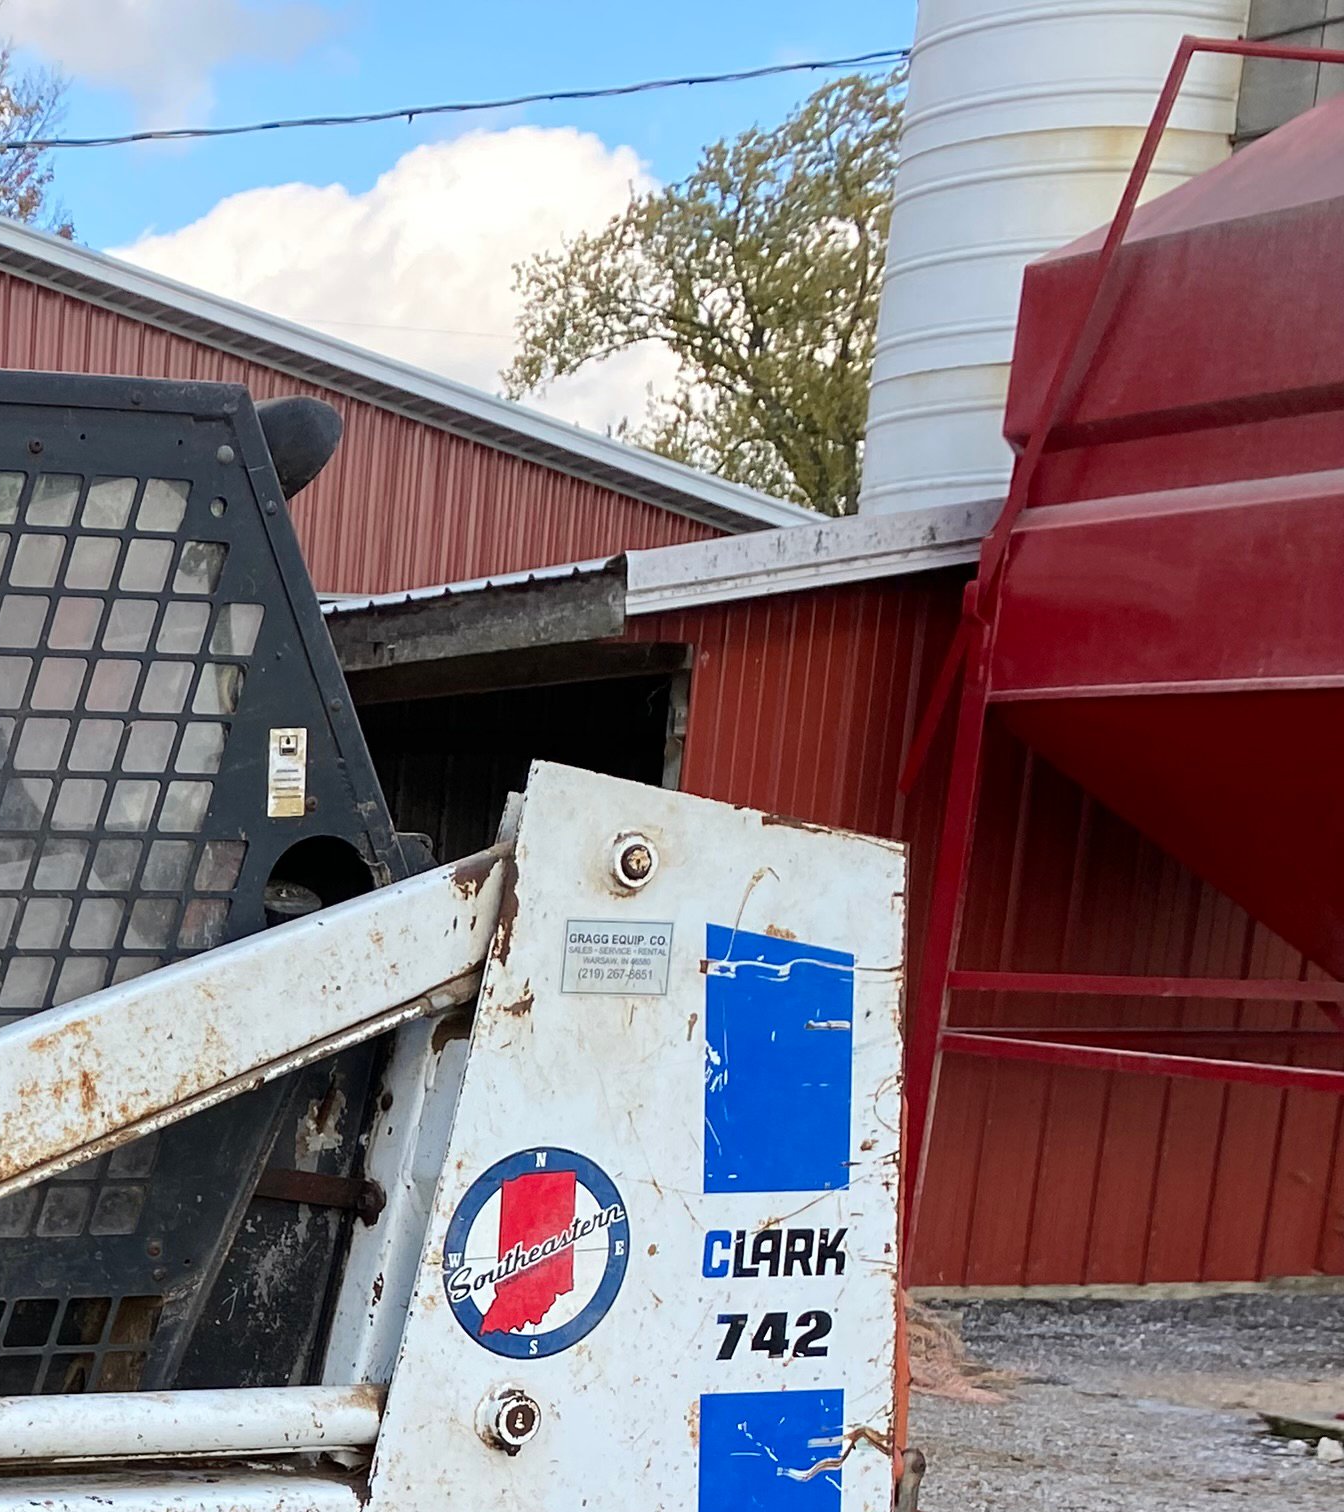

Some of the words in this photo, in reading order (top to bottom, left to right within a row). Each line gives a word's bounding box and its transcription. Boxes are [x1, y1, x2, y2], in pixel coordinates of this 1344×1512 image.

[569, 933, 609, 944] GRAGG
[650, 935, 668, 946] CO.
[568, 946, 593, 954] SALES
[599, 946, 631, 955] SERVICE
[638, 947, 667, 957] RENTAL
[621, 957, 629, 965] IN
[577, 967, 604, 980] (219)
[535, 1152, 547, 1168] N
[449, 1204, 624, 1301] Southeastern
[614, 1240, 625, 1256] E
[702, 1228, 848, 1279] CLARK
[447, 1253, 462, 1268] W
[716, 1310, 833, 1360] 742
[528, 1340, 538, 1355] S
